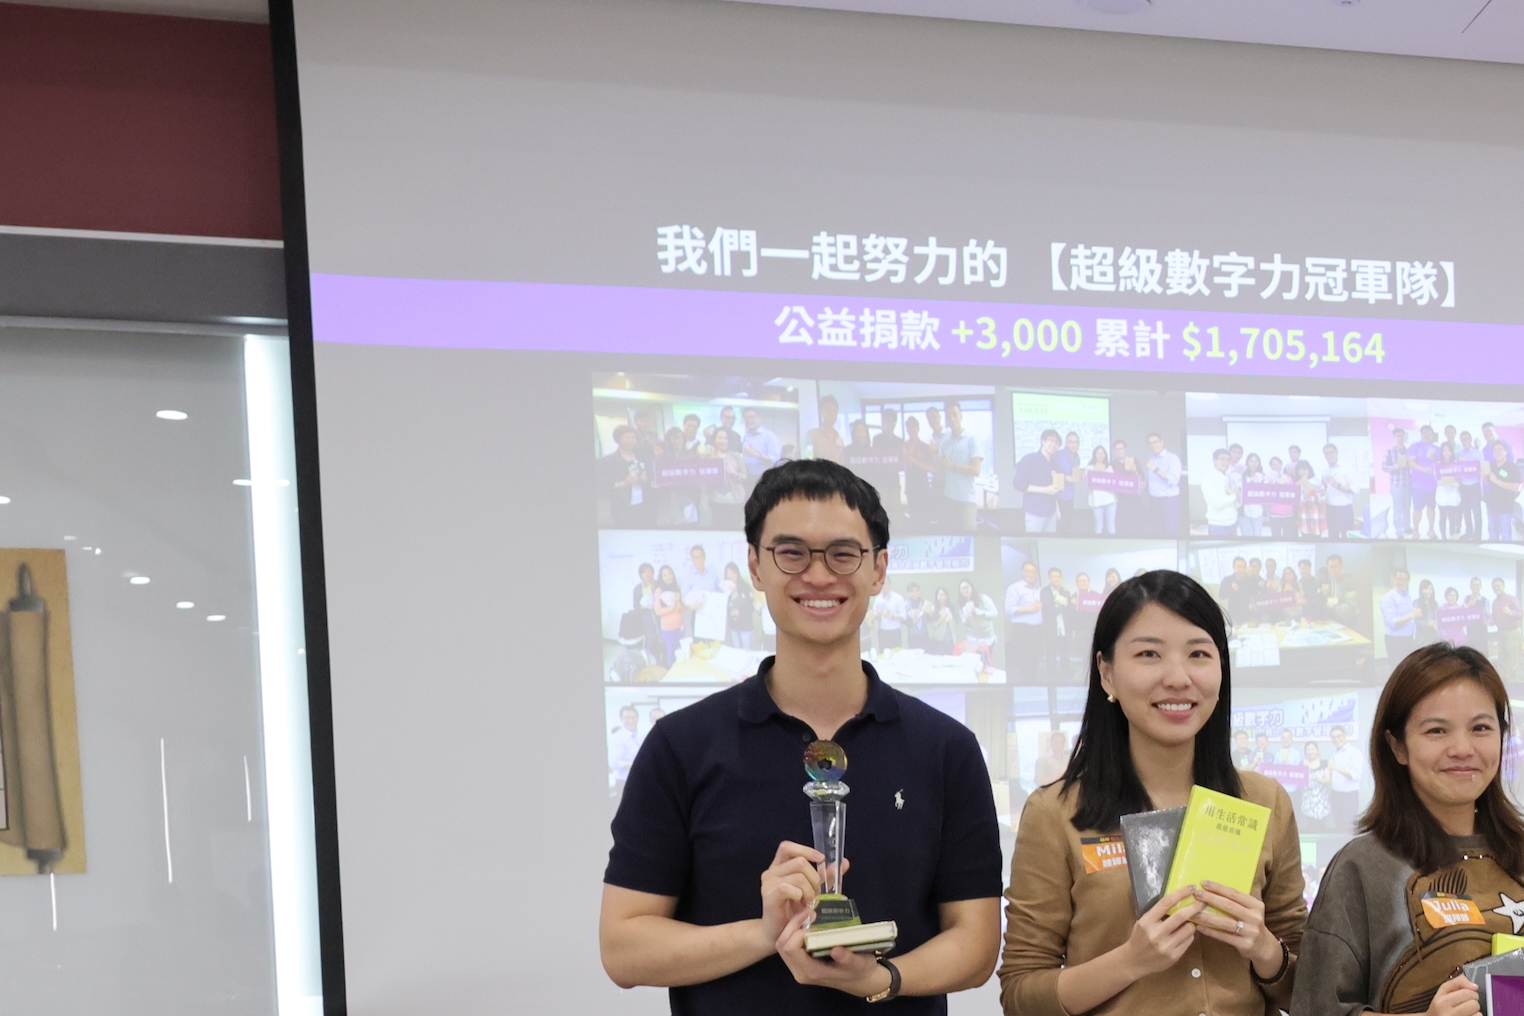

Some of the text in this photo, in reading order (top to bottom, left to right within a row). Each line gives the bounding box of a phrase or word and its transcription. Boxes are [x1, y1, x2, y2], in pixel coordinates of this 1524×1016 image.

[656, 223, 1456, 308] 我們一起努力的 【超級數字力冠軍隊】
[774, 305, 1385, 368] 公益捐款 +3,000 累計 $1,705,164
[1205, 804, 1258, 831] 用生活常識
[1096, 843, 1126, 857] Mil
[1433, 899, 1470, 911] Julia
